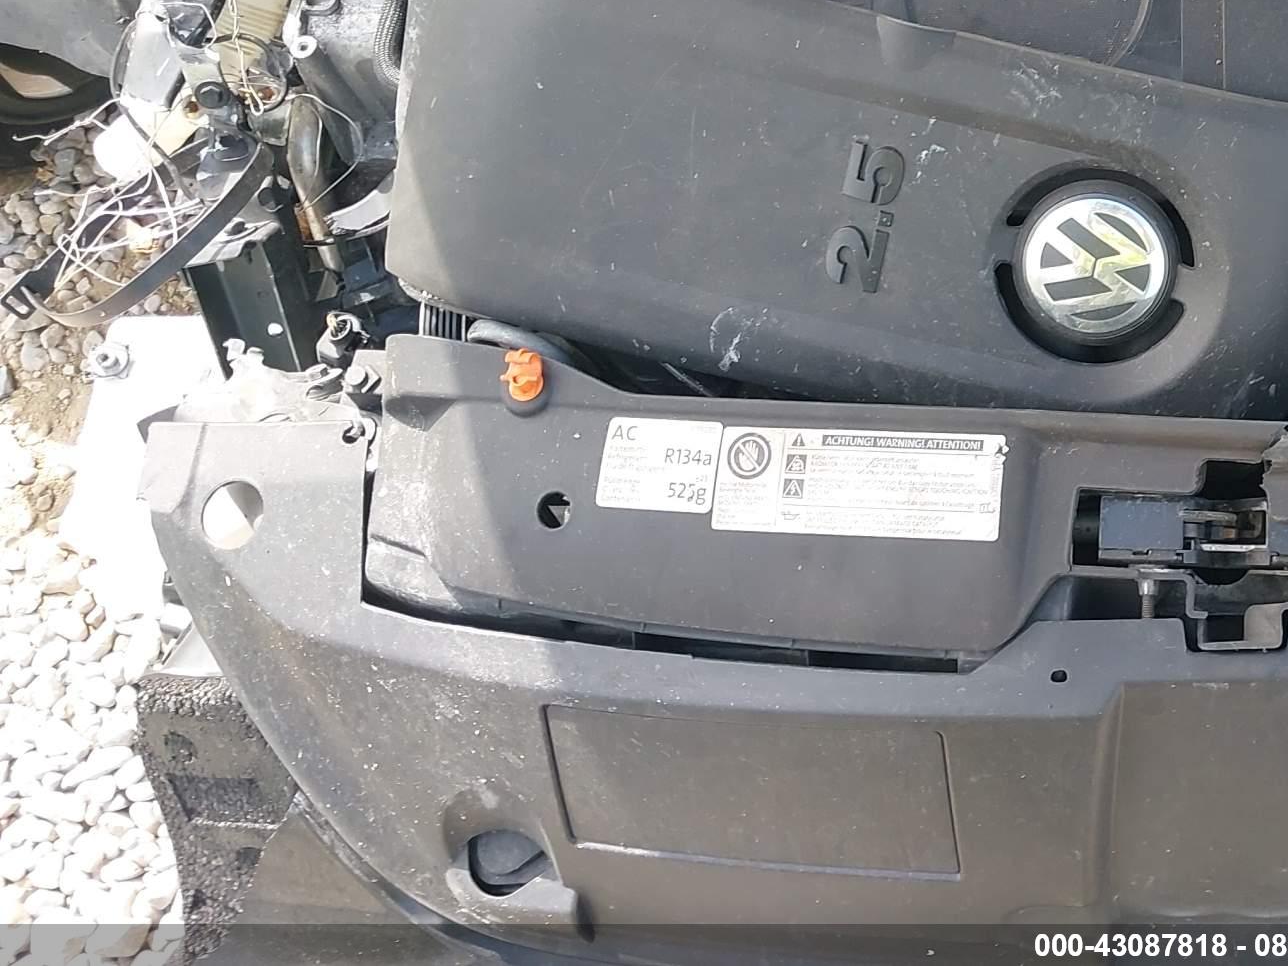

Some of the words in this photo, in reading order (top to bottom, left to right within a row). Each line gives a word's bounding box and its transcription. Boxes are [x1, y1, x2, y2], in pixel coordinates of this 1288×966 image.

[825, 135, 905, 294] 2.5
[612, 425, 638, 441] AC
[825, 437, 875, 447] ACHTUNG!
[876, 438, 925, 449] WARNING!
[926, 439, 982, 450] ATTENTION!
[665, 448, 712, 466] R134a
